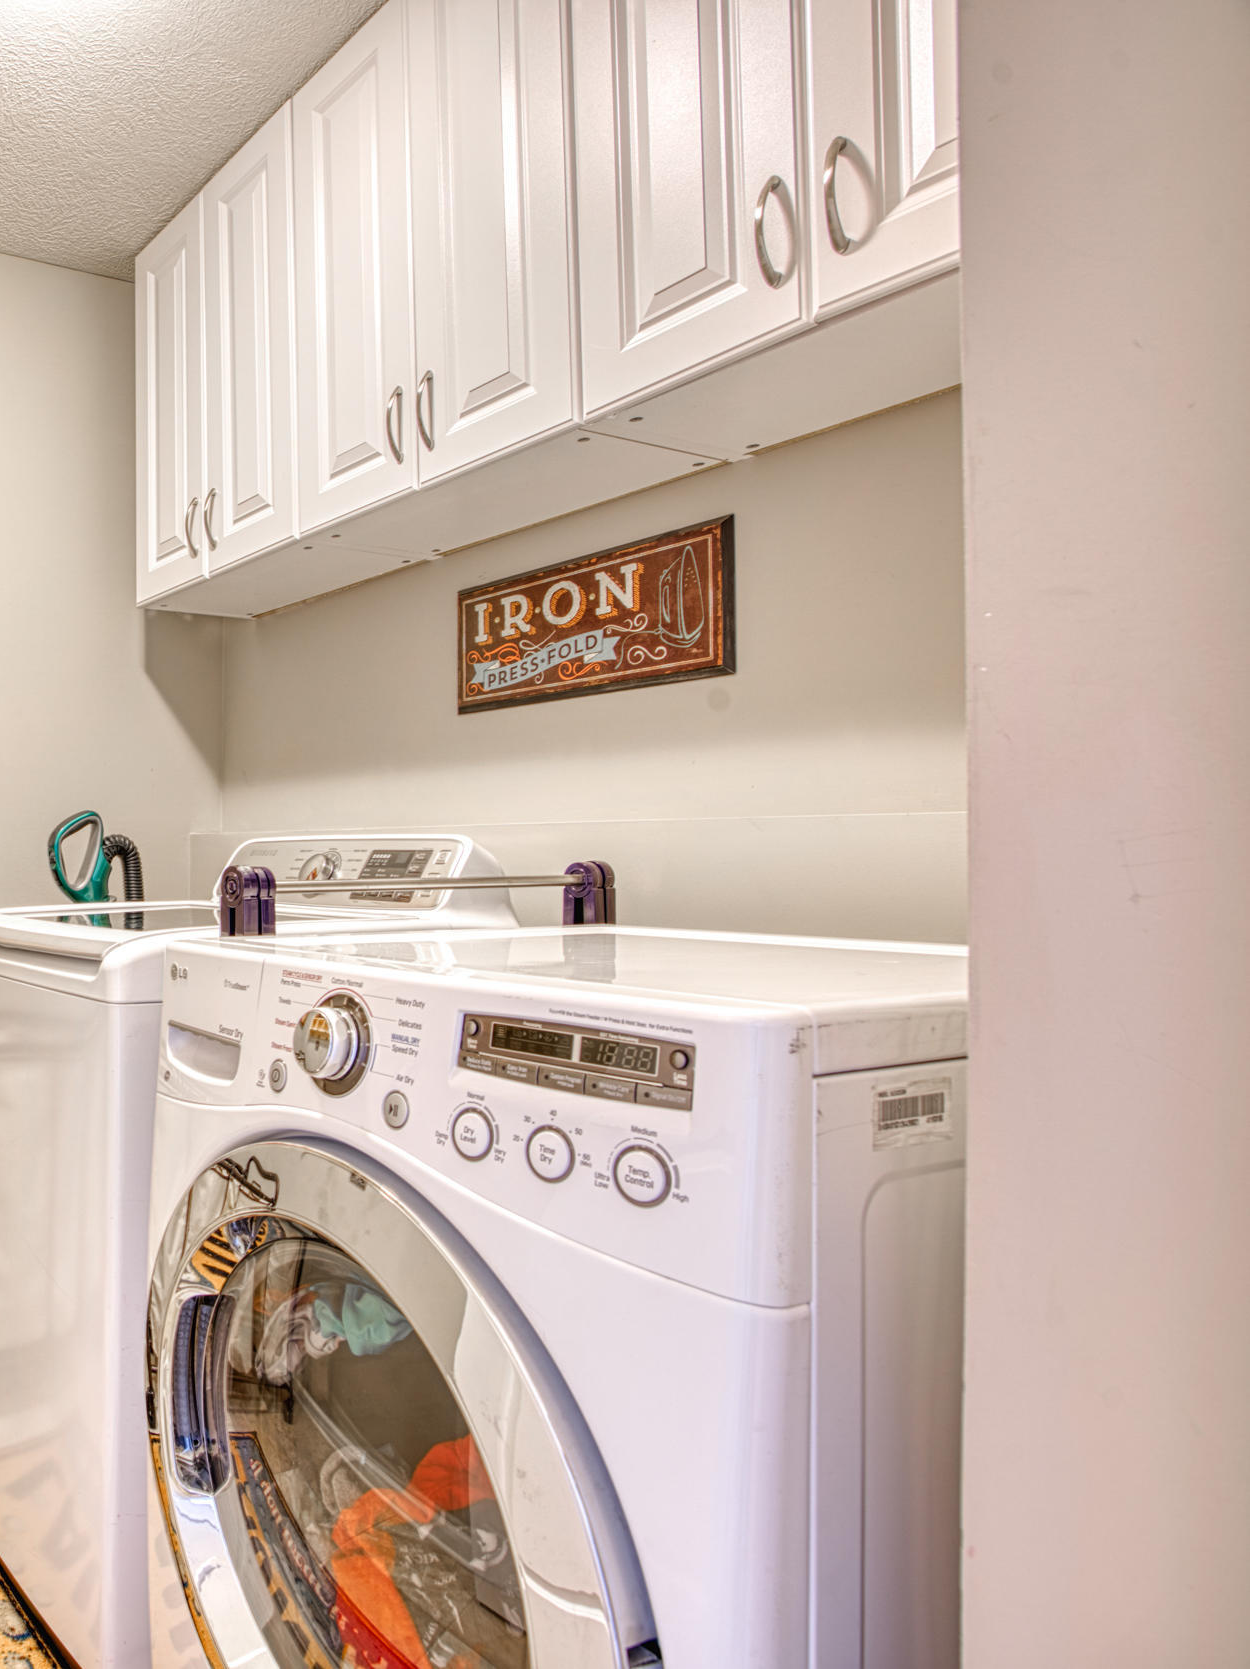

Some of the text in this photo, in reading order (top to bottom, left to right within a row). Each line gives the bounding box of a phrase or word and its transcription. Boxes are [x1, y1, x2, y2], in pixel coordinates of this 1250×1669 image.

[395, 997, 426, 1010] Heavy Duty
[398, 1019, 422, 1030] Delicates
[219, 1024, 244, 1040] Sensor Dry
[391, 1044, 418, 1057] Speed Dry
[404, 1075, 415, 1086] Dry
[467, 1092, 485, 1101] Normal
[435, 1130, 449, 1141] Damp
[463, 1126, 475, 1136] Dry
[575, 1128, 583, 1136] 50
[631, 1124, 658, 1138] Medium
[437, 1138, 446, 1147] Dry
[460, 1133, 476, 1144] Level
[539, 1144, 556, 1156] Time
[494, 1154, 504, 1164] Dry
[540, 1153, 553, 1165] Dry
[594, 1171, 610, 1182] Ultra
[627, 1165, 651, 1180] Temp.
[594, 1180, 609, 1189] Low
[625, 1174, 655, 1189] Control
[672, 1192, 690, 1204] High
